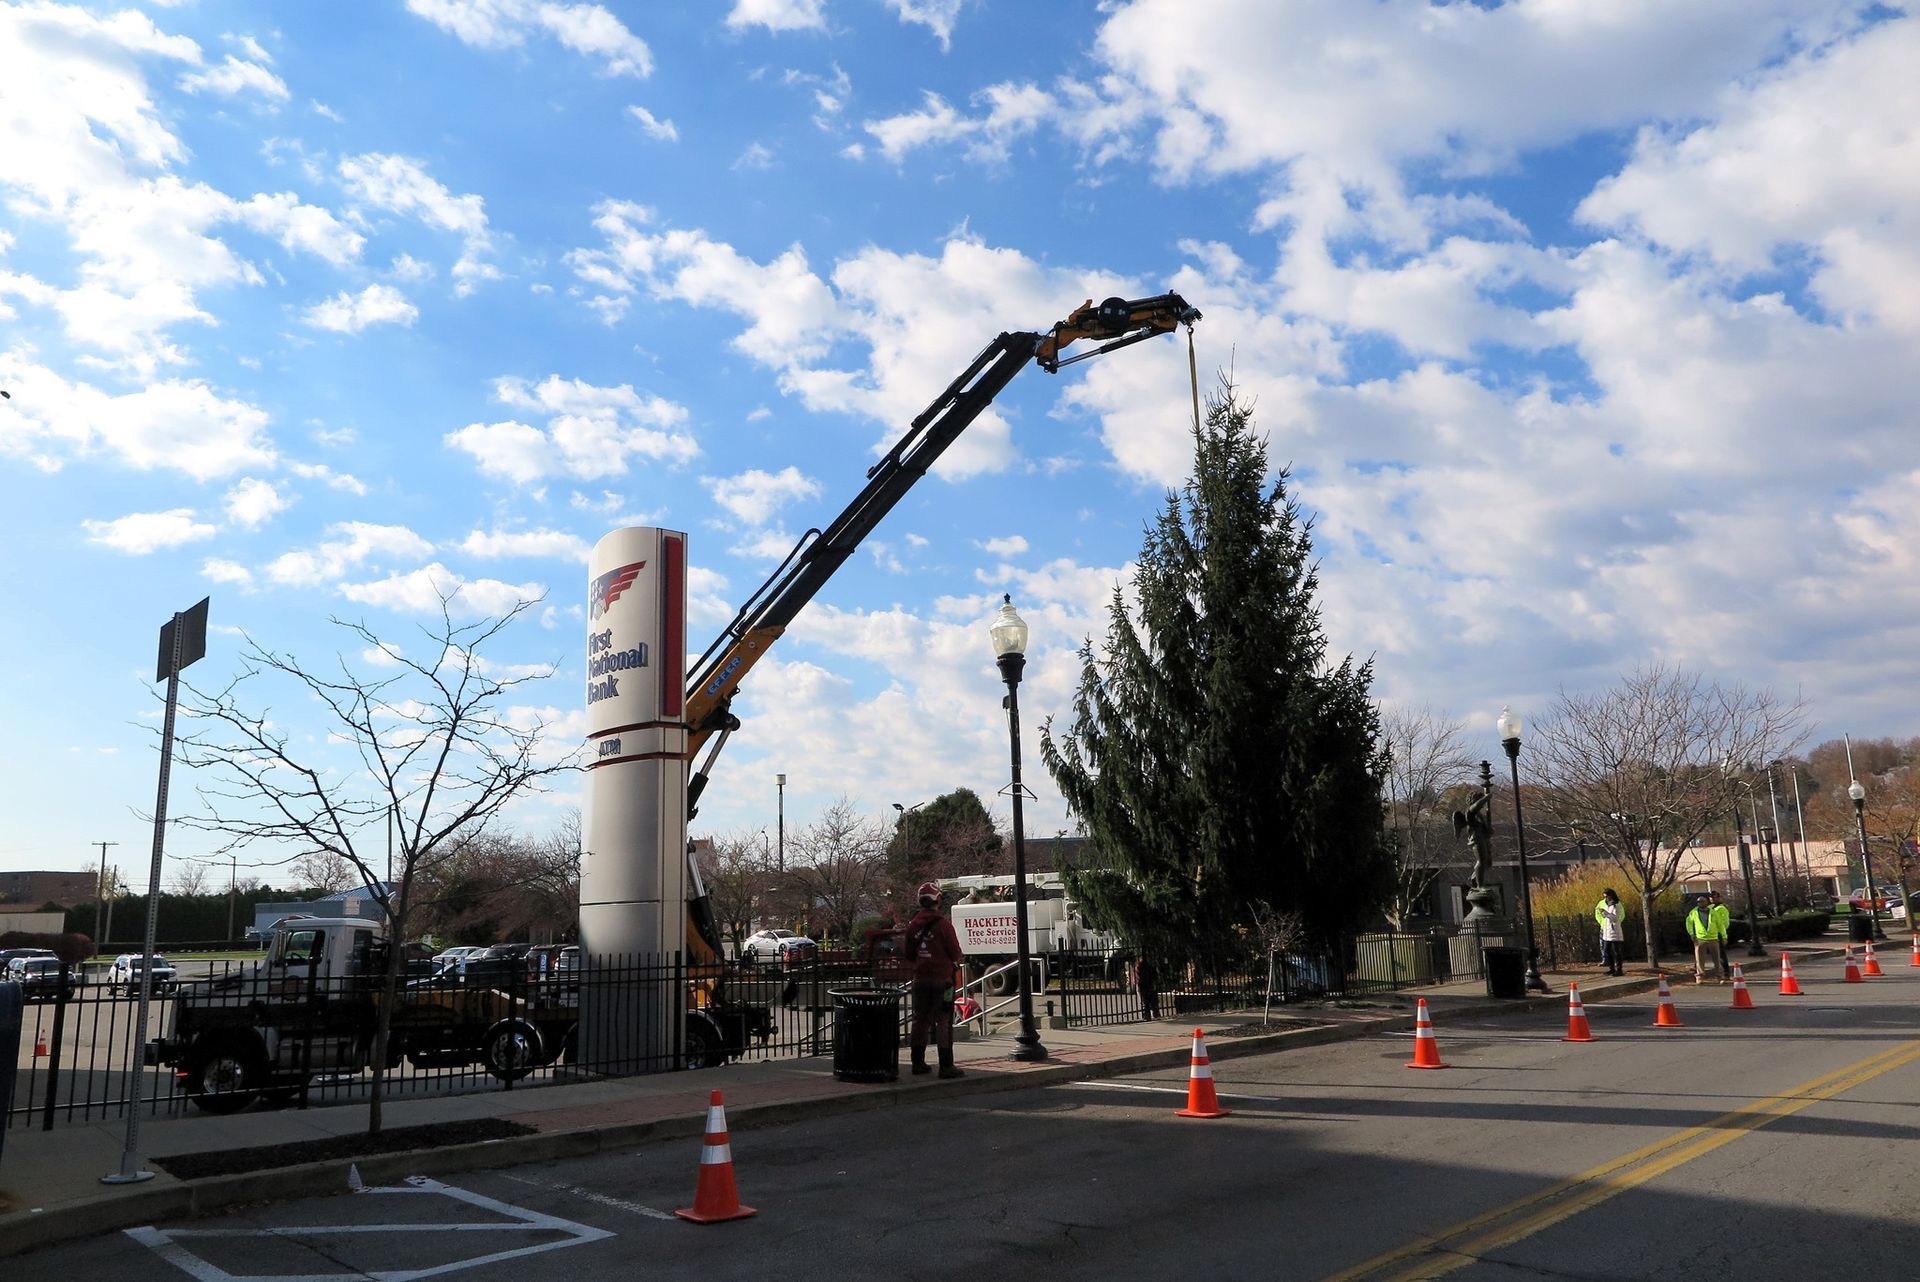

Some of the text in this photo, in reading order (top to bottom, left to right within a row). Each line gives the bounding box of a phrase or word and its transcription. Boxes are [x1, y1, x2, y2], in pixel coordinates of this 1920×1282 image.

[589, 628, 612, 656] First
[588, 642, 648, 680] National
[588, 675, 619, 705] Bank
[707, 656, 742, 696] EFFER
[599, 738, 621, 757] ATM
[964, 916, 1018, 928] HACKETT'S
[967, 928, 1016, 937] Tree Service
